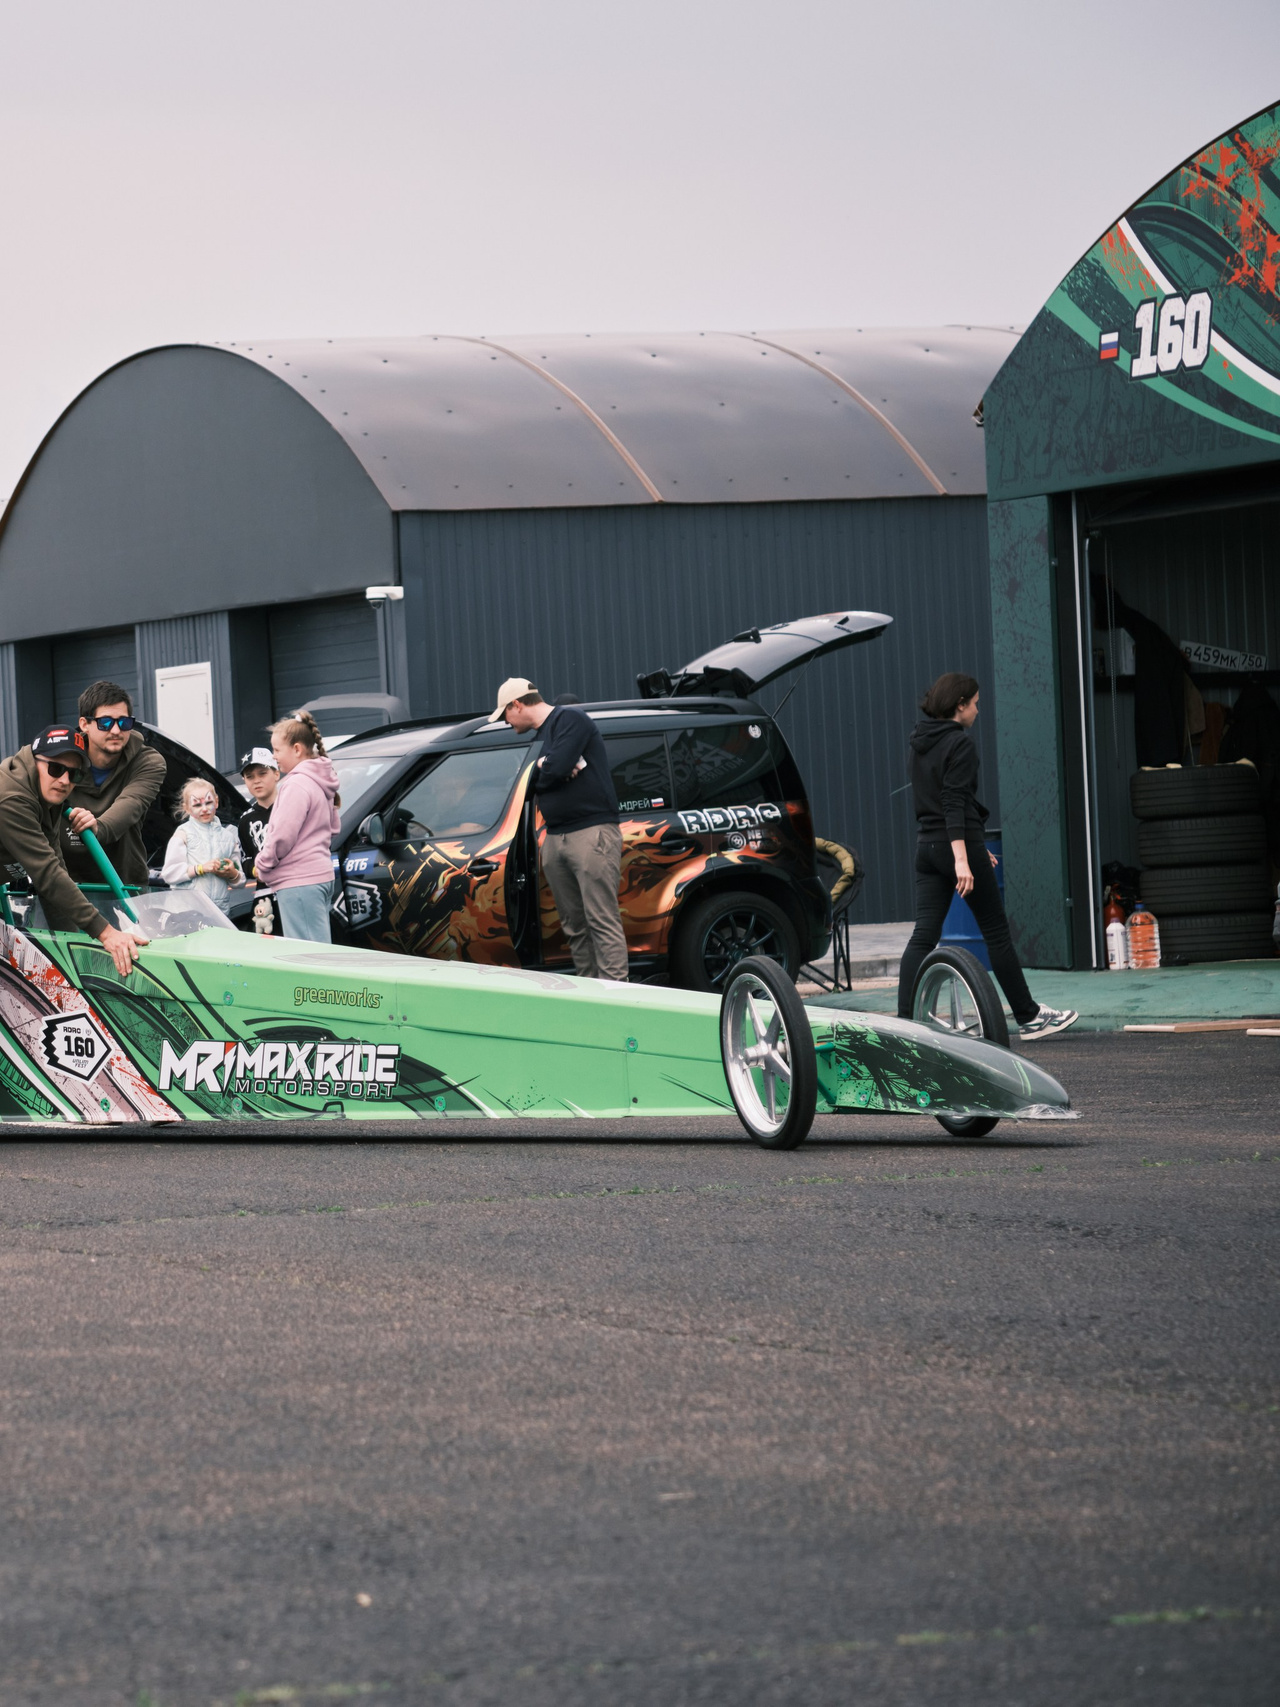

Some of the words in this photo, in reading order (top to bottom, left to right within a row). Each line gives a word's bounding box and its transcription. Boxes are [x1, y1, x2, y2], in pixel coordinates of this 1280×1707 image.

[1131, 290, 1212, 378] 160
[678, 803, 782, 834] RDRC
[346, 857, 369, 872] ВТБ
[294, 987, 381, 1008] greenworks
[63, 1026, 81, 1034] RDRC
[64, 1035, 95, 1058] 160
[234, 1079, 396, 1097] MOTORSPORT
